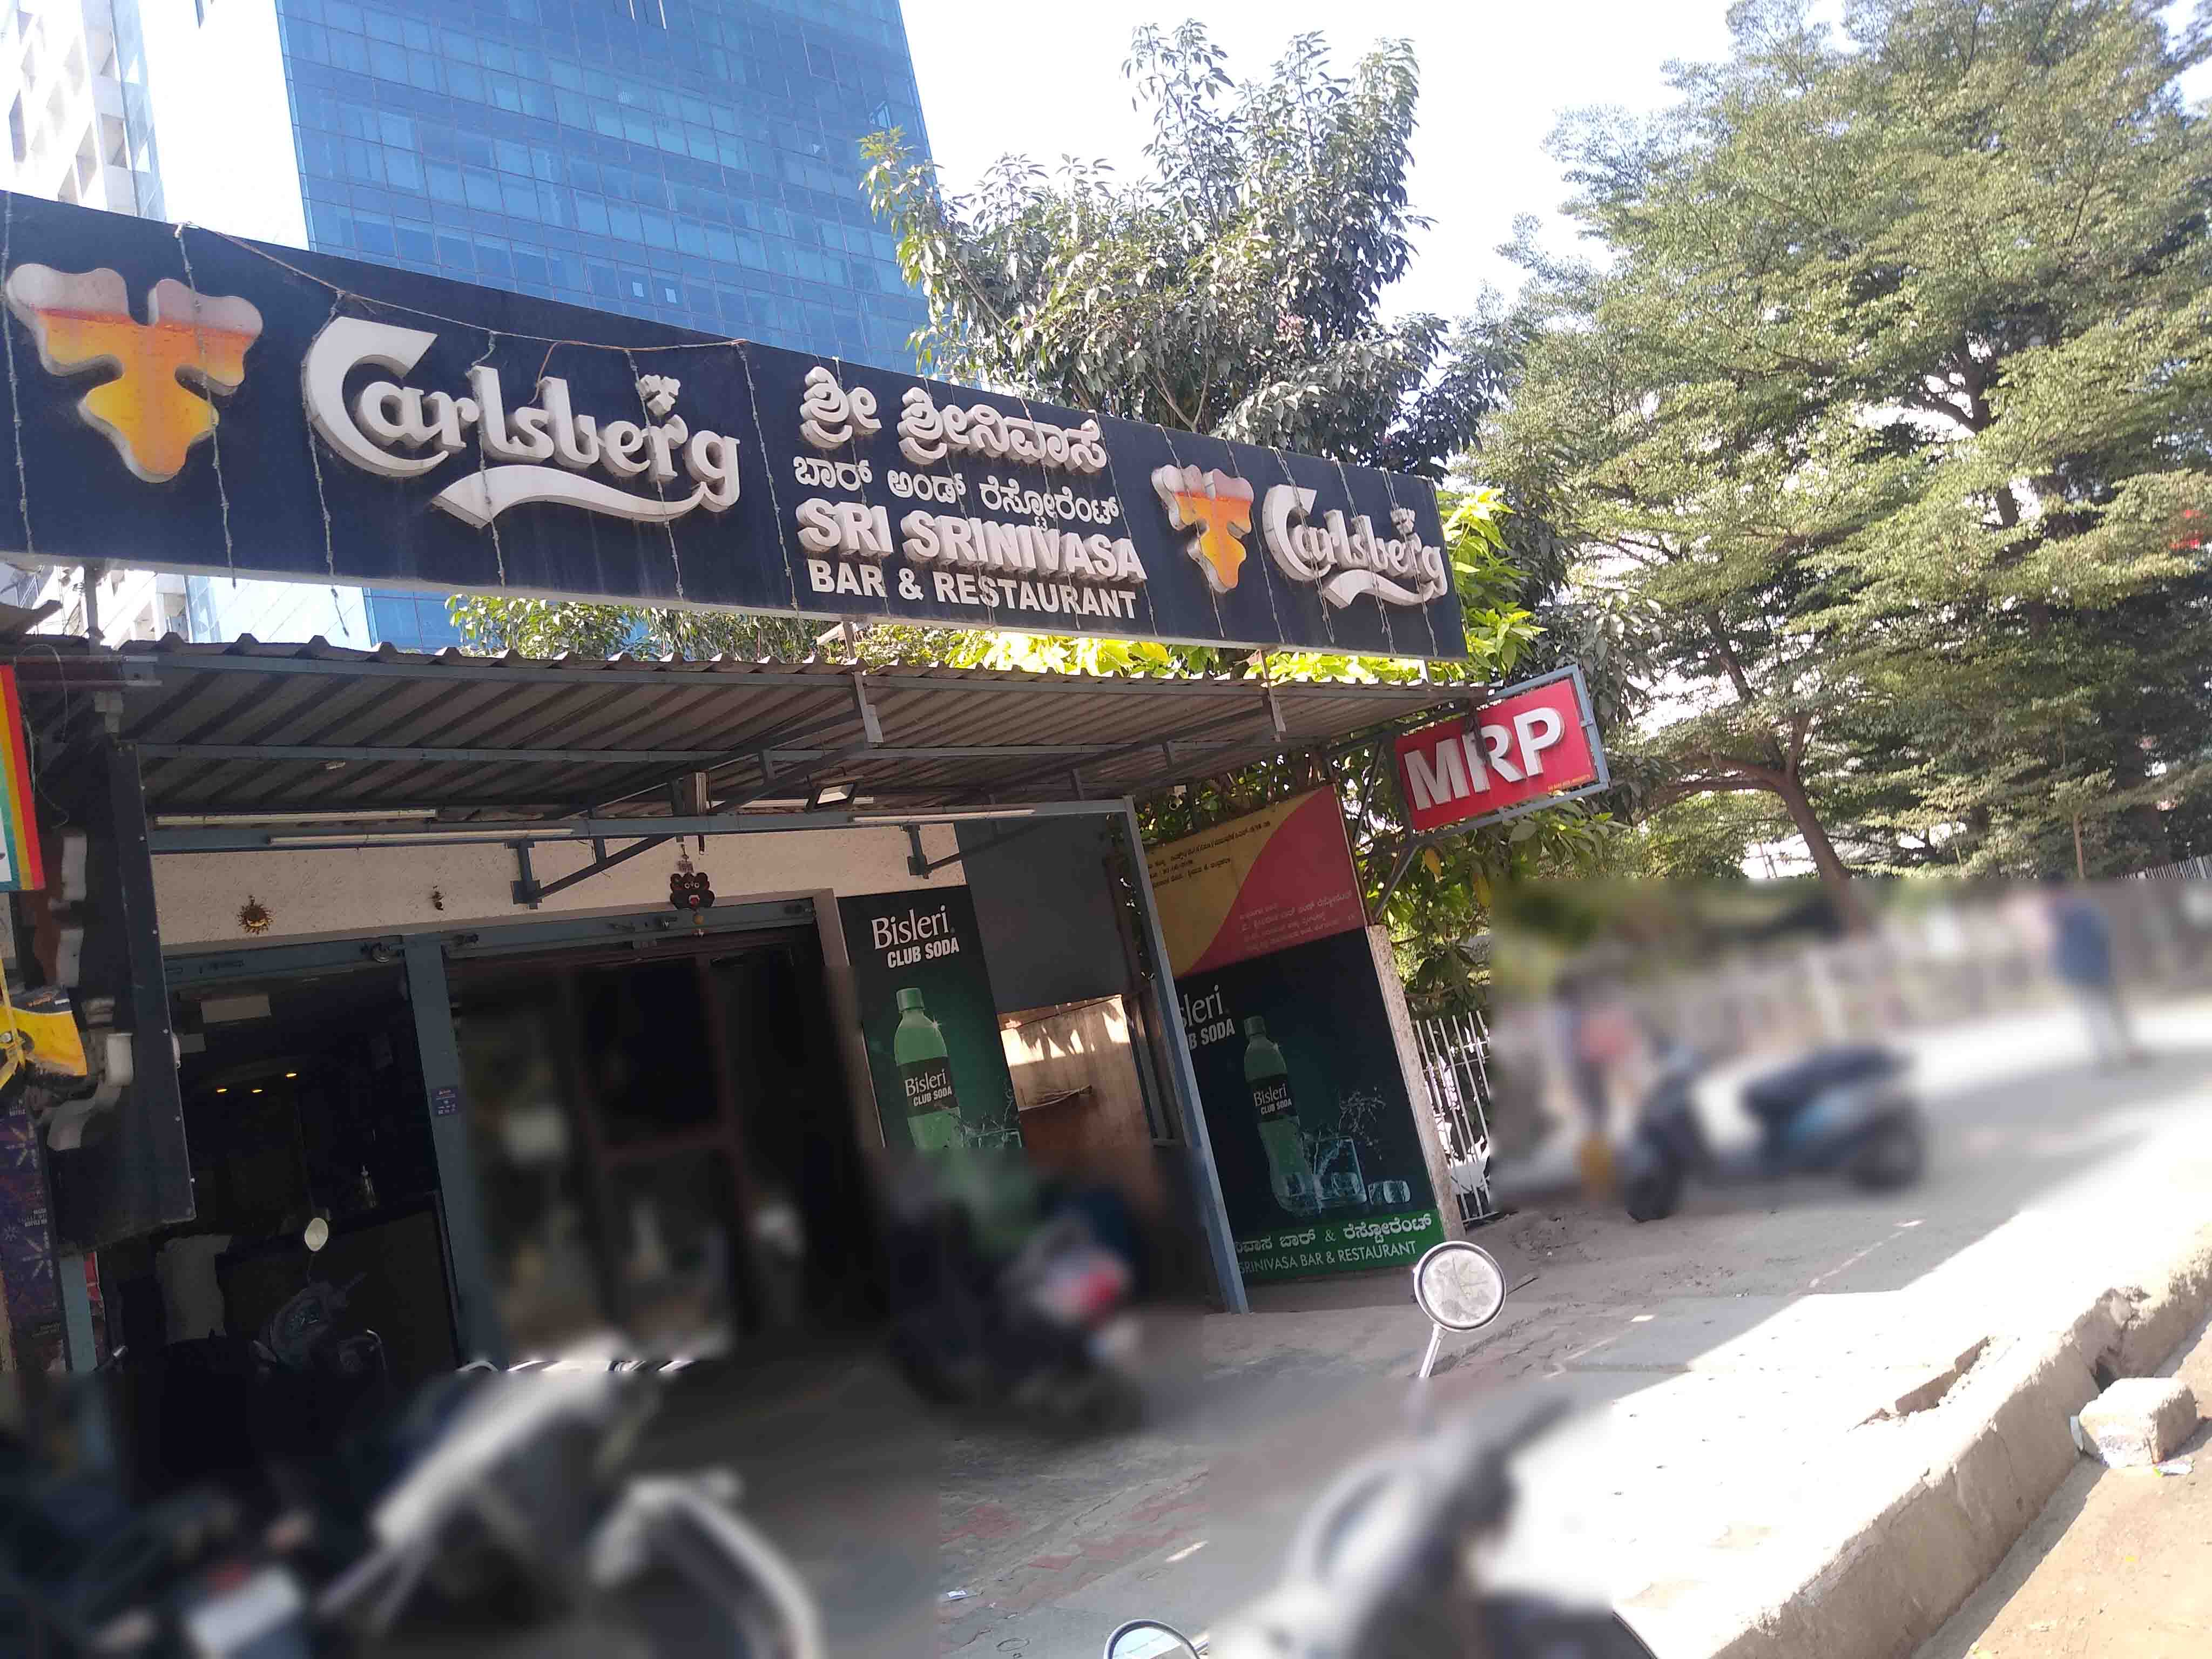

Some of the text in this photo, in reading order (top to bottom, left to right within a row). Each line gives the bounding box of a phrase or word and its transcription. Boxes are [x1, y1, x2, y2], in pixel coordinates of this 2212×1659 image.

[302, 316, 739, 528] Carlsberg
[800, 366, 1107, 473] ಶ್ರೀ ಶ್ರೀನಿವಾಸ
[793, 456, 873, 491] ಬಾರ್
[796, 498, 1148, 583] SRI SRINIVASA
[1262, 484, 1448, 609] Carlsberg
[808, 559, 1136, 619] BAR & RESTAURANT
[1404, 707, 1564, 810] MRP
[872, 905, 950, 950] Bisleri
[887, 938, 960, 968] CLUB SODA
[1201, 1019, 1235, 1045] SODA
[904, 1069, 947, 1097] Bisleri
[913, 1086, 953, 1107] CLUB SODA
[1253, 1082, 1287, 1107] Bisleri
[1324, 1229, 1337, 1242] &
[1299, 1251, 1324, 1267] BAR
[1326, 1251, 1336, 1264] &
[1338, 1240, 1417, 1263] RESTAURANT
